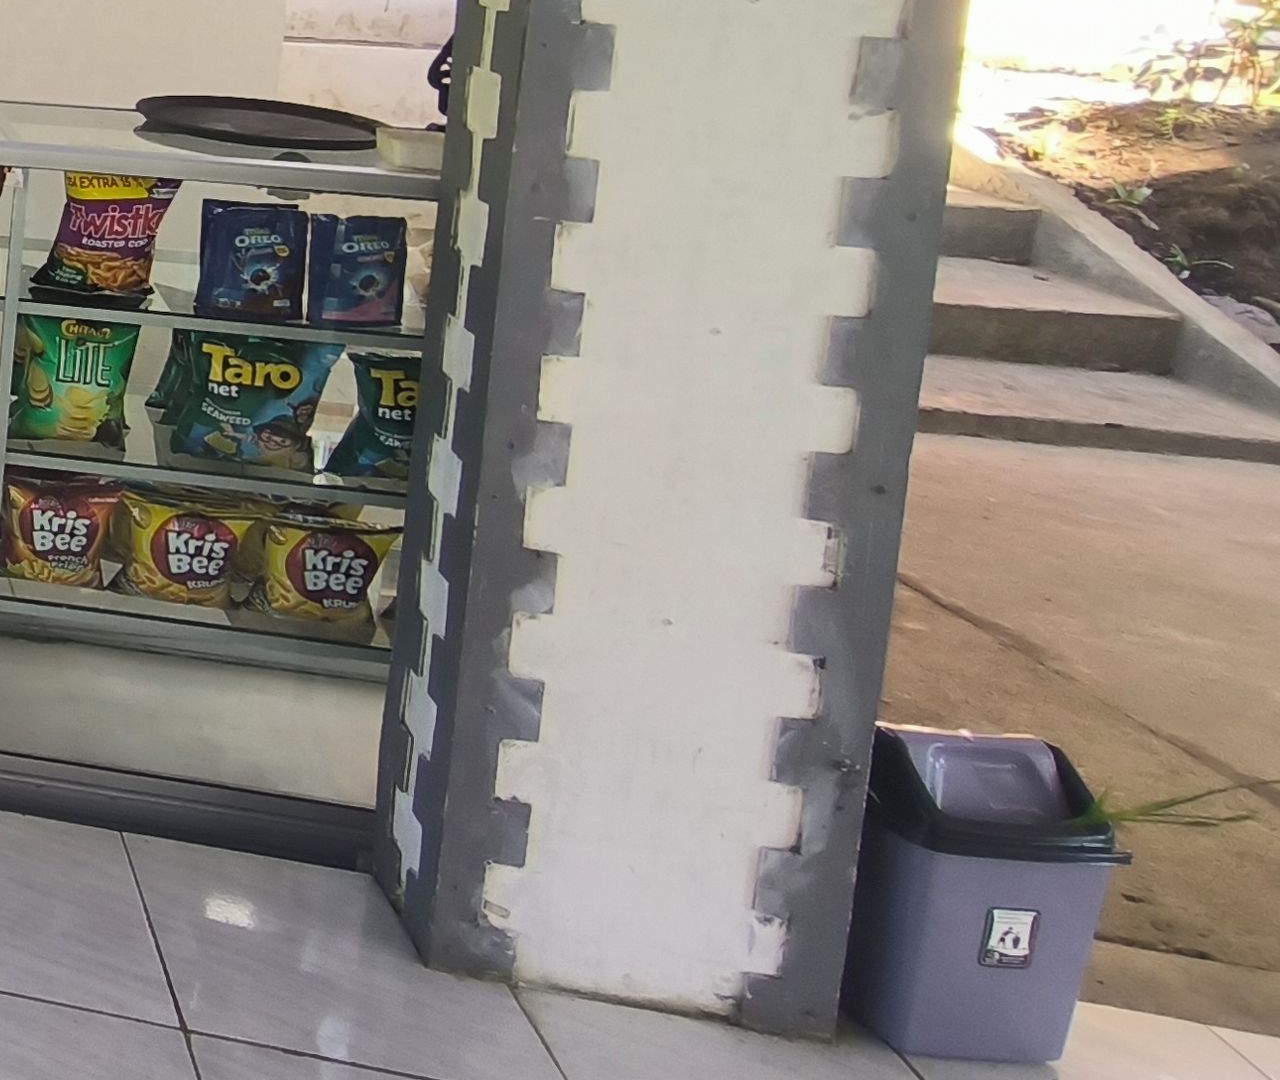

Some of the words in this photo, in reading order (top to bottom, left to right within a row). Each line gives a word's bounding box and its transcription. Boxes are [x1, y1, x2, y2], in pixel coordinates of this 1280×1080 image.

[81, 176, 118, 189] EXTRA
[234, 235, 282, 247] OREO
[341, 241, 389, 253] OREO
[202, 342, 301, 390] Taro
[208, 382, 239, 398] net
[201, 401, 252, 426] SEAWEED
[377, 406, 412, 421] net
[32, 509, 91, 536] Kris
[32, 531, 88, 552] Bee
[167, 531, 230, 559] Kris
[167, 554, 224, 576] Bee
[304, 549, 369, 576] Kris
[304, 571, 364, 595] Bee
